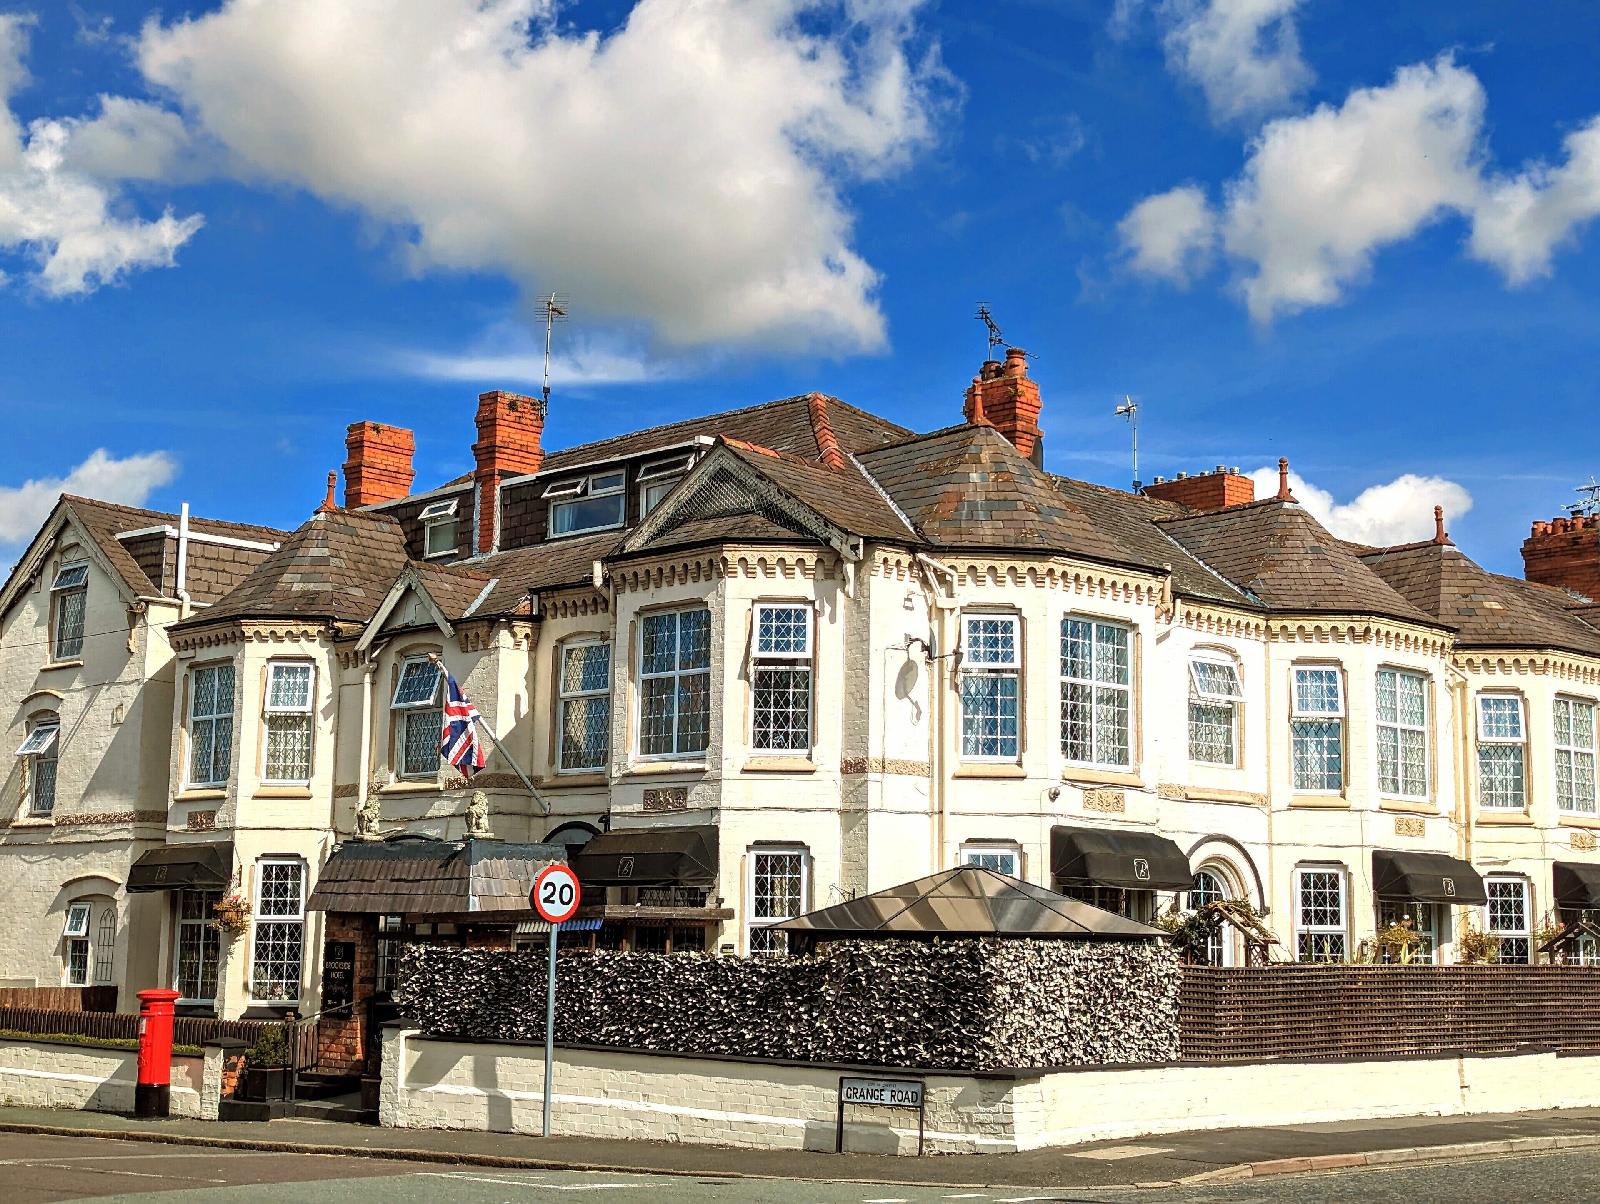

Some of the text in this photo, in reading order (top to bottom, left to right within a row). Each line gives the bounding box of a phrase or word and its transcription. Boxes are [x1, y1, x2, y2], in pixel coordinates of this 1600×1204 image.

[543, 882, 573, 905] 20
[846, 1087, 918, 1103] GRANGE ROAD
